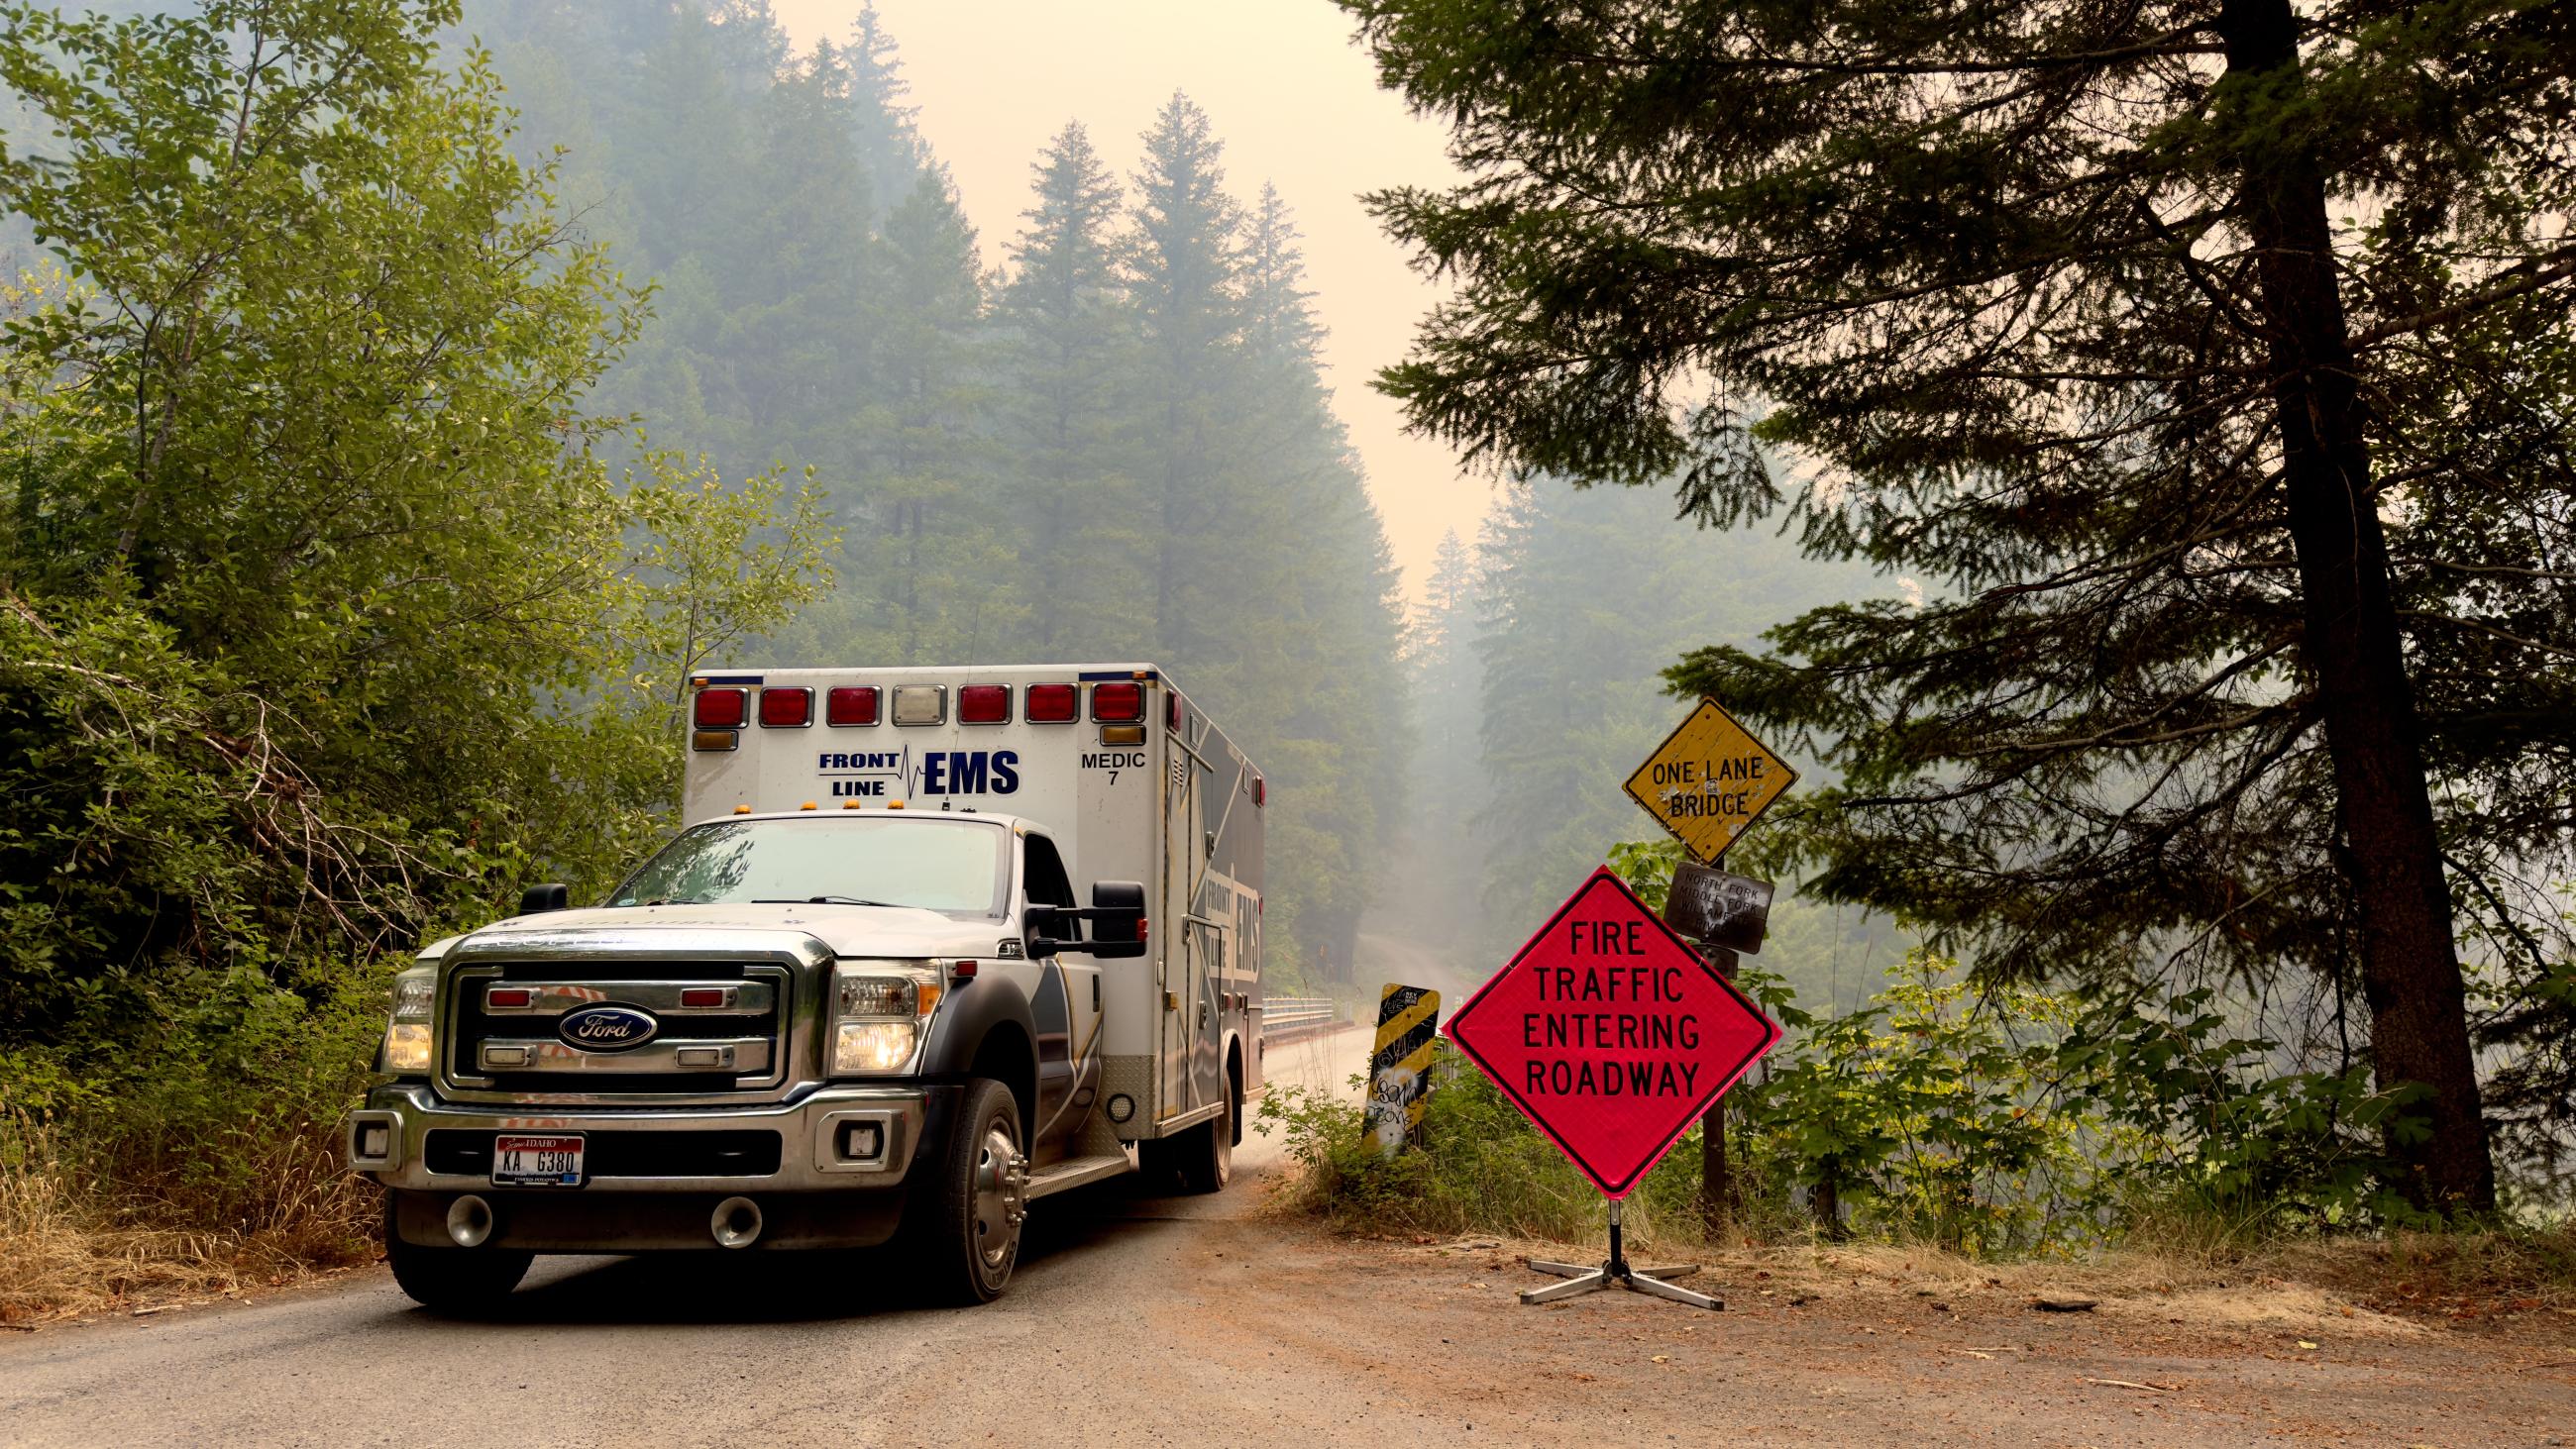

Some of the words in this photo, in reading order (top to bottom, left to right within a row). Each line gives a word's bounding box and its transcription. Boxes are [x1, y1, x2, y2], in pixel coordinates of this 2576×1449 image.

[819, 753, 900, 769] FRONT
[924, 751, 1019, 794] EMS
[1082, 753, 1146, 769] MEDIC
[1653, 761, 1695, 785] ONE
[1706, 757, 1764, 782] LANE
[832, 780, 885, 795] LINE
[1108, 772, 1119, 785] 7
[1670, 791, 1749, 818] BRIDGE
[1679, 885, 1721, 905] MIDDLE
[1727, 898, 1758, 914] FORK
[1685, 873, 1723, 890] NORTH
[1728, 883, 1759, 900] FORK
[1207, 879, 1231, 915] FRONT
[1235, 892, 1258, 974] EMS
[1570, 921, 1646, 955] FIRE
[1211, 937, 1227, 968] LIE
[1534, 967, 1683, 1002] TRAFFIC
[578, 1014, 632, 1038] Ford
[1524, 1013, 1699, 1050] ENTERING
[1527, 1060, 1700, 1097] ROADWAY
[525, 1139, 556, 1148] IDAHO
[503, 1150, 520, 1172] KA
[537, 1151, 575, 1173] G380
